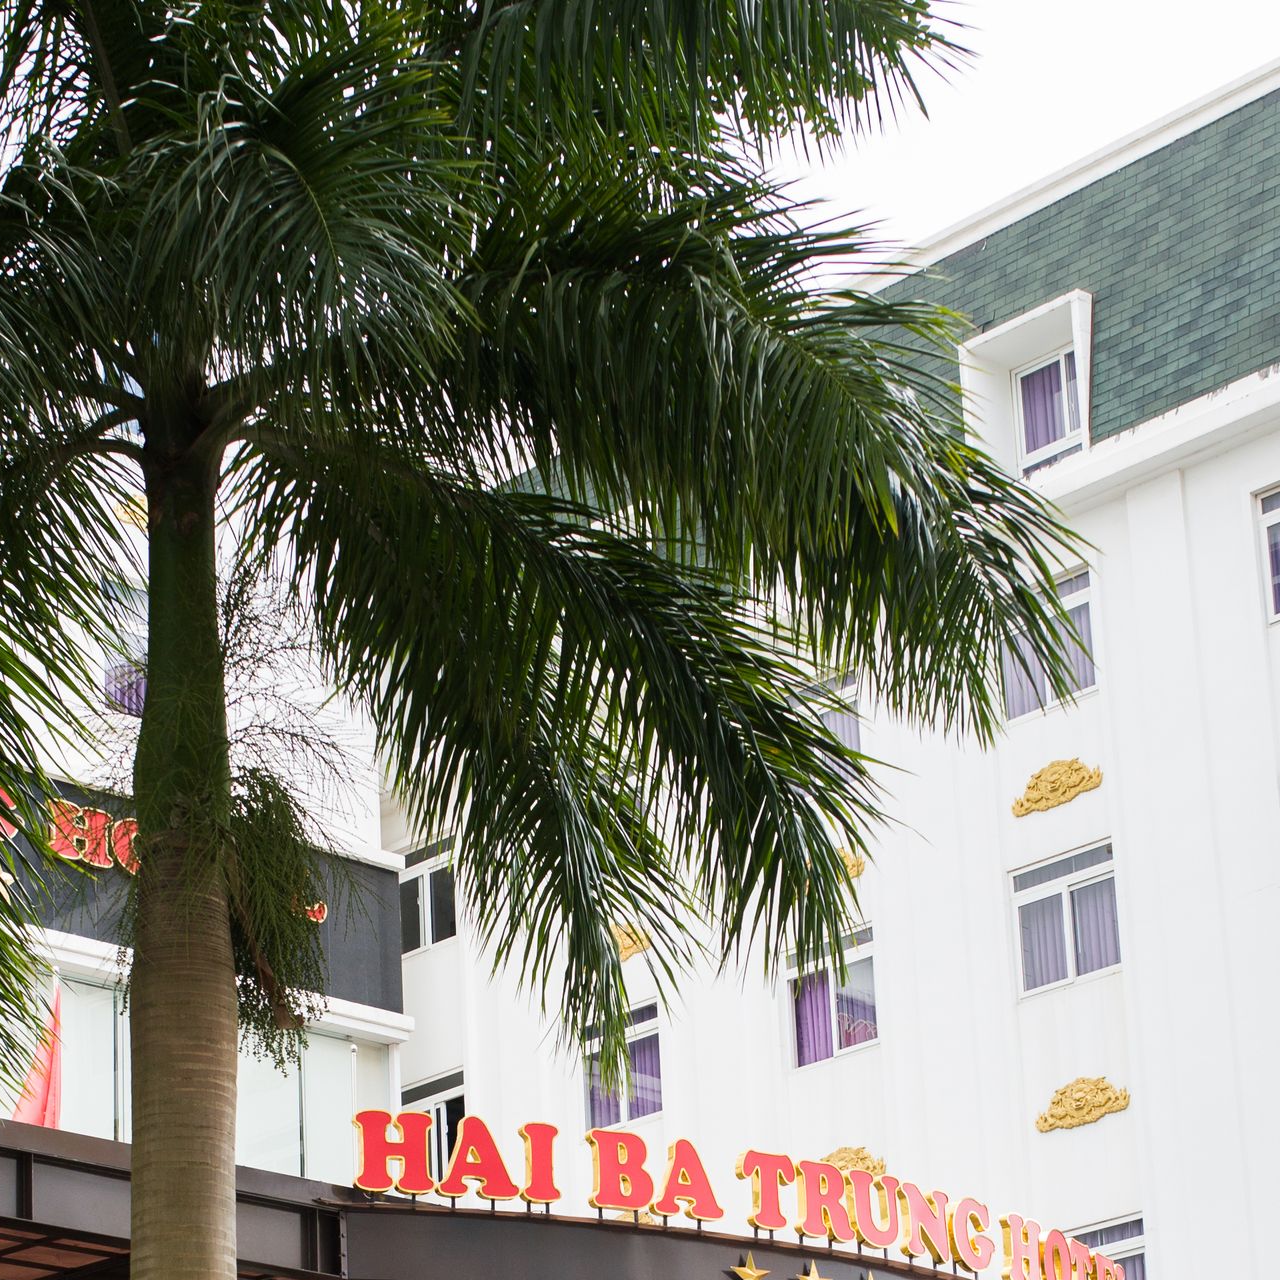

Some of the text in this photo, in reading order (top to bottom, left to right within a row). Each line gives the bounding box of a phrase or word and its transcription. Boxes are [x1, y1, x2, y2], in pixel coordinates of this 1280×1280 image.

[353, 1110, 562, 1204] HAI
[586, 1127, 723, 1222] BA
[735, 1150, 997, 1274] TRUNG
